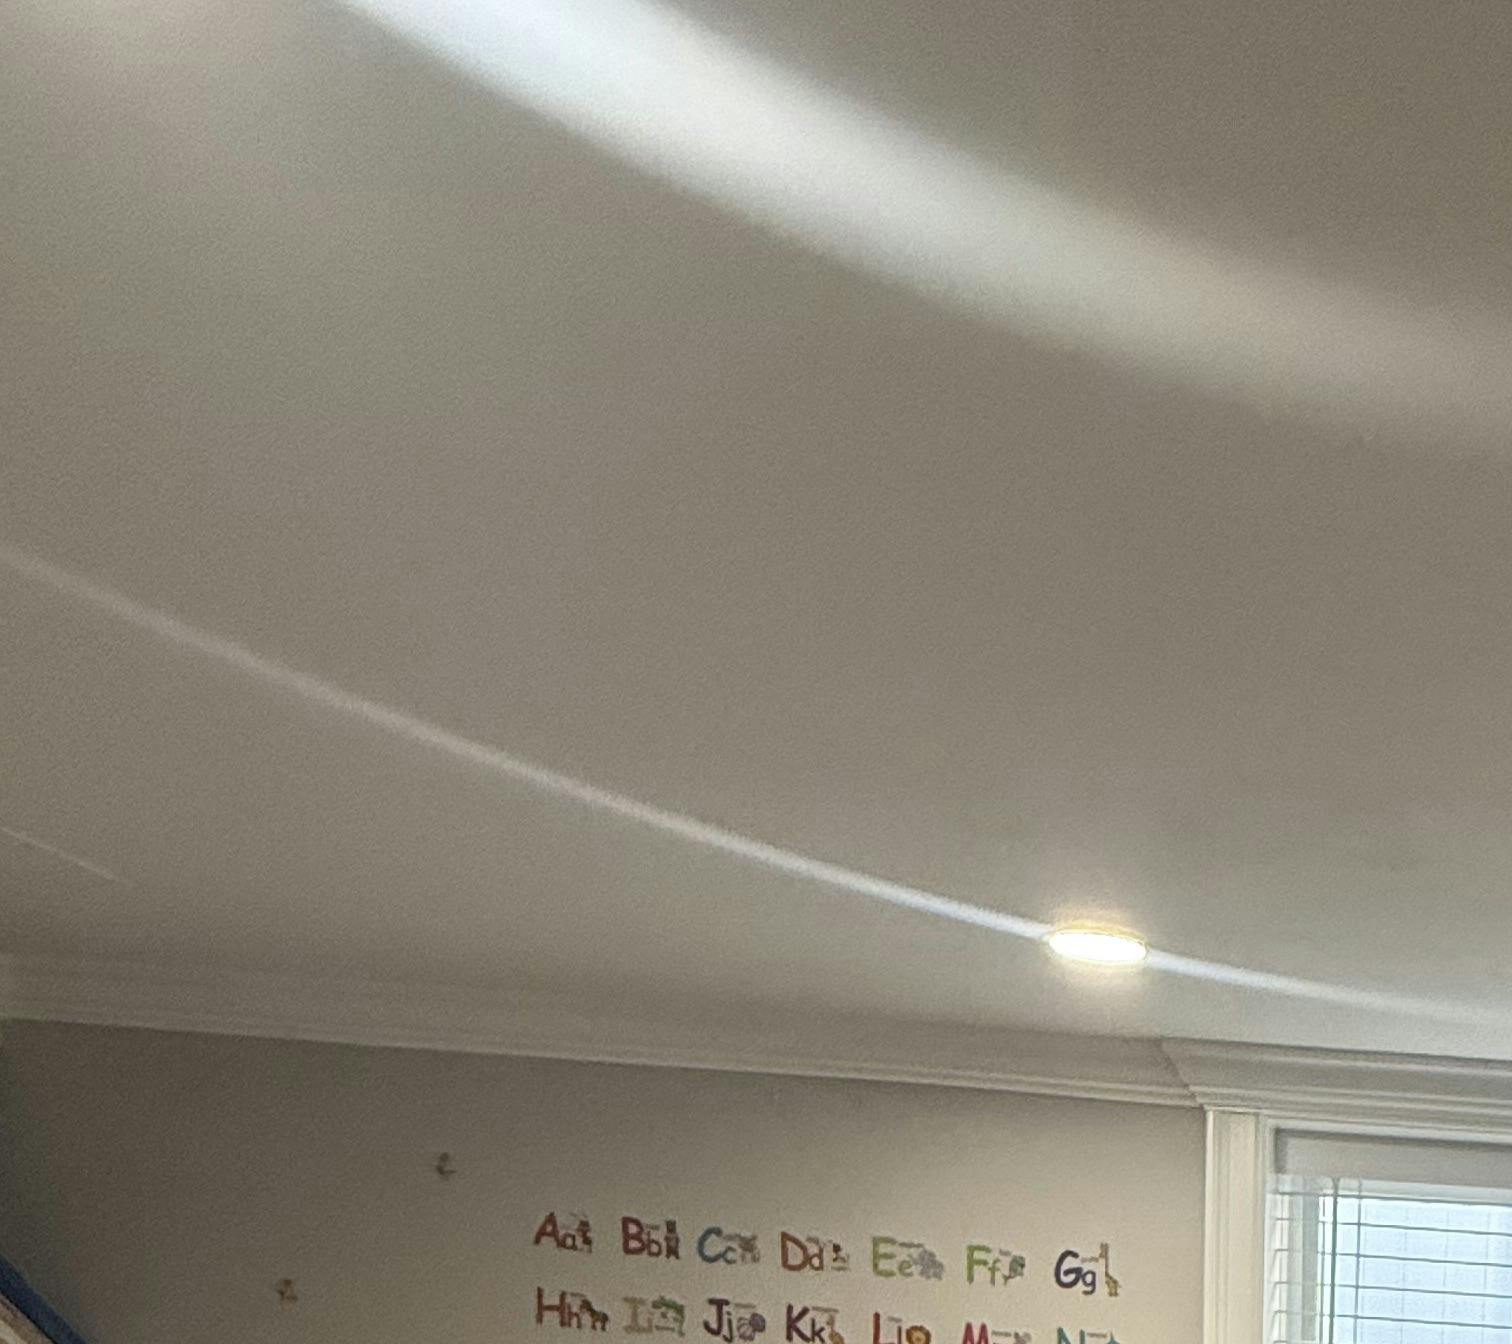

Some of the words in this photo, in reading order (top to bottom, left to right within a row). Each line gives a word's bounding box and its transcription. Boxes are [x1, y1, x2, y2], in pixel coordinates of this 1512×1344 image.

[534, 1212, 577, 1251] Aa
[621, 1216, 662, 1257] Bb
[697, 1226, 736, 1264] Cc
[780, 1231, 824, 1271] Dd
[872, 1236, 913, 1278] Ee
[966, 1245, 1000, 1287] Ff
[1054, 1250, 1096, 1296] Gg
[535, 1286, 582, 1329] Hh
[704, 1298, 733, 1343] Jj
[785, 1304, 826, 1344] Kk
